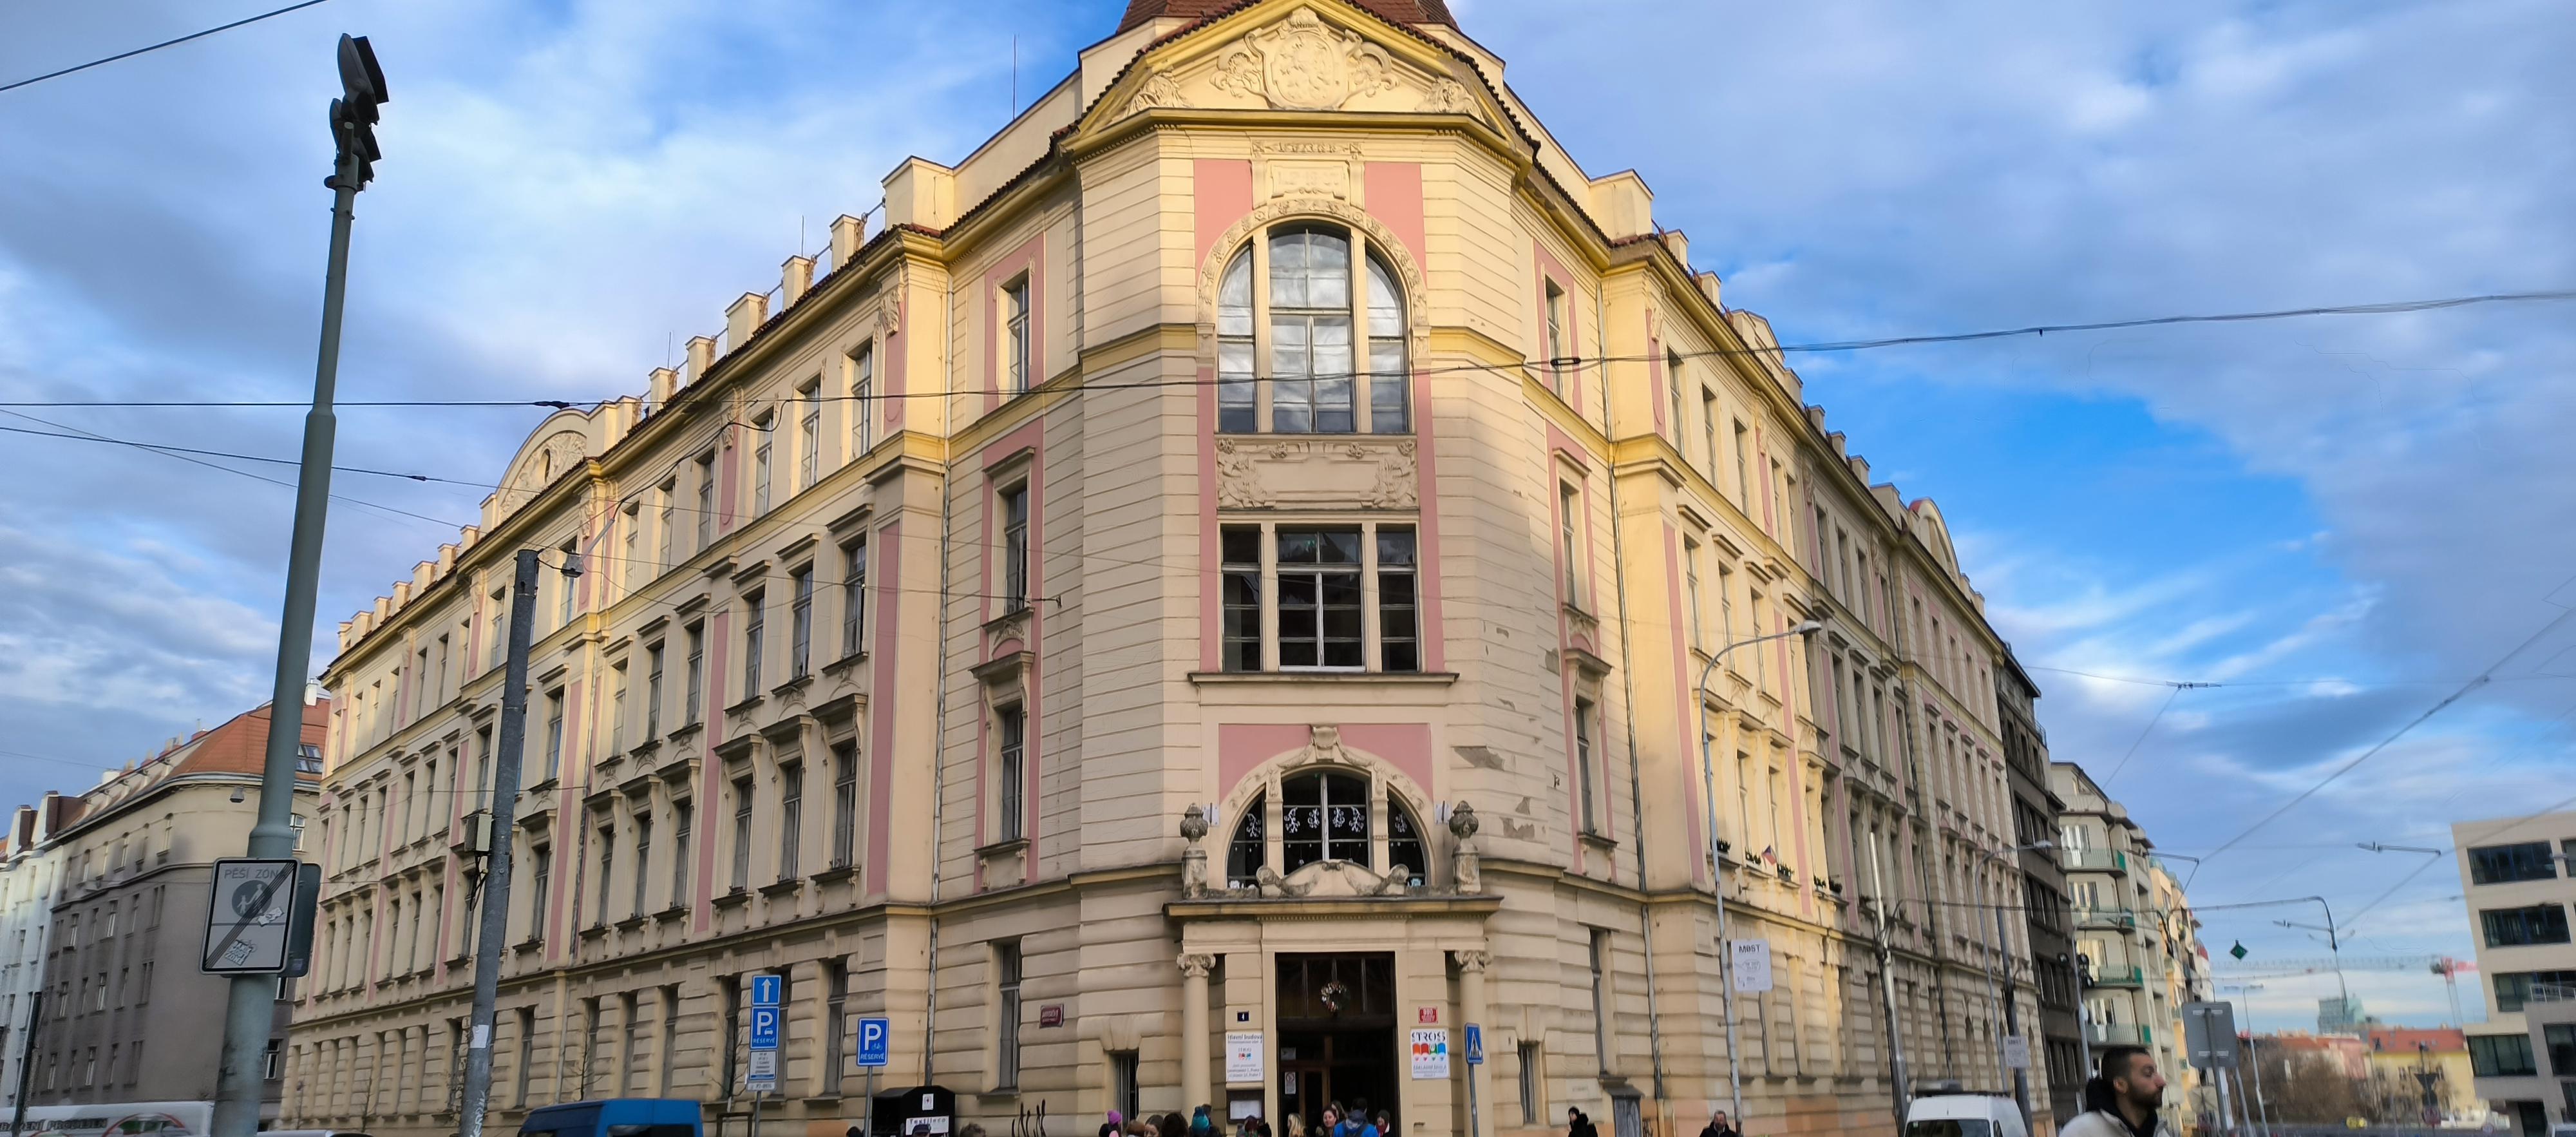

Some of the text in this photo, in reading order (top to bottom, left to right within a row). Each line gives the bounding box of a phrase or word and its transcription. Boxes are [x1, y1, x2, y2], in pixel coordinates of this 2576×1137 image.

[224, 866, 251, 879] PĚŠÍ
[757, 1011, 773, 1036] P
[864, 1024, 882, 1051] P
[1412, 1031, 1445, 1042] STROSS
